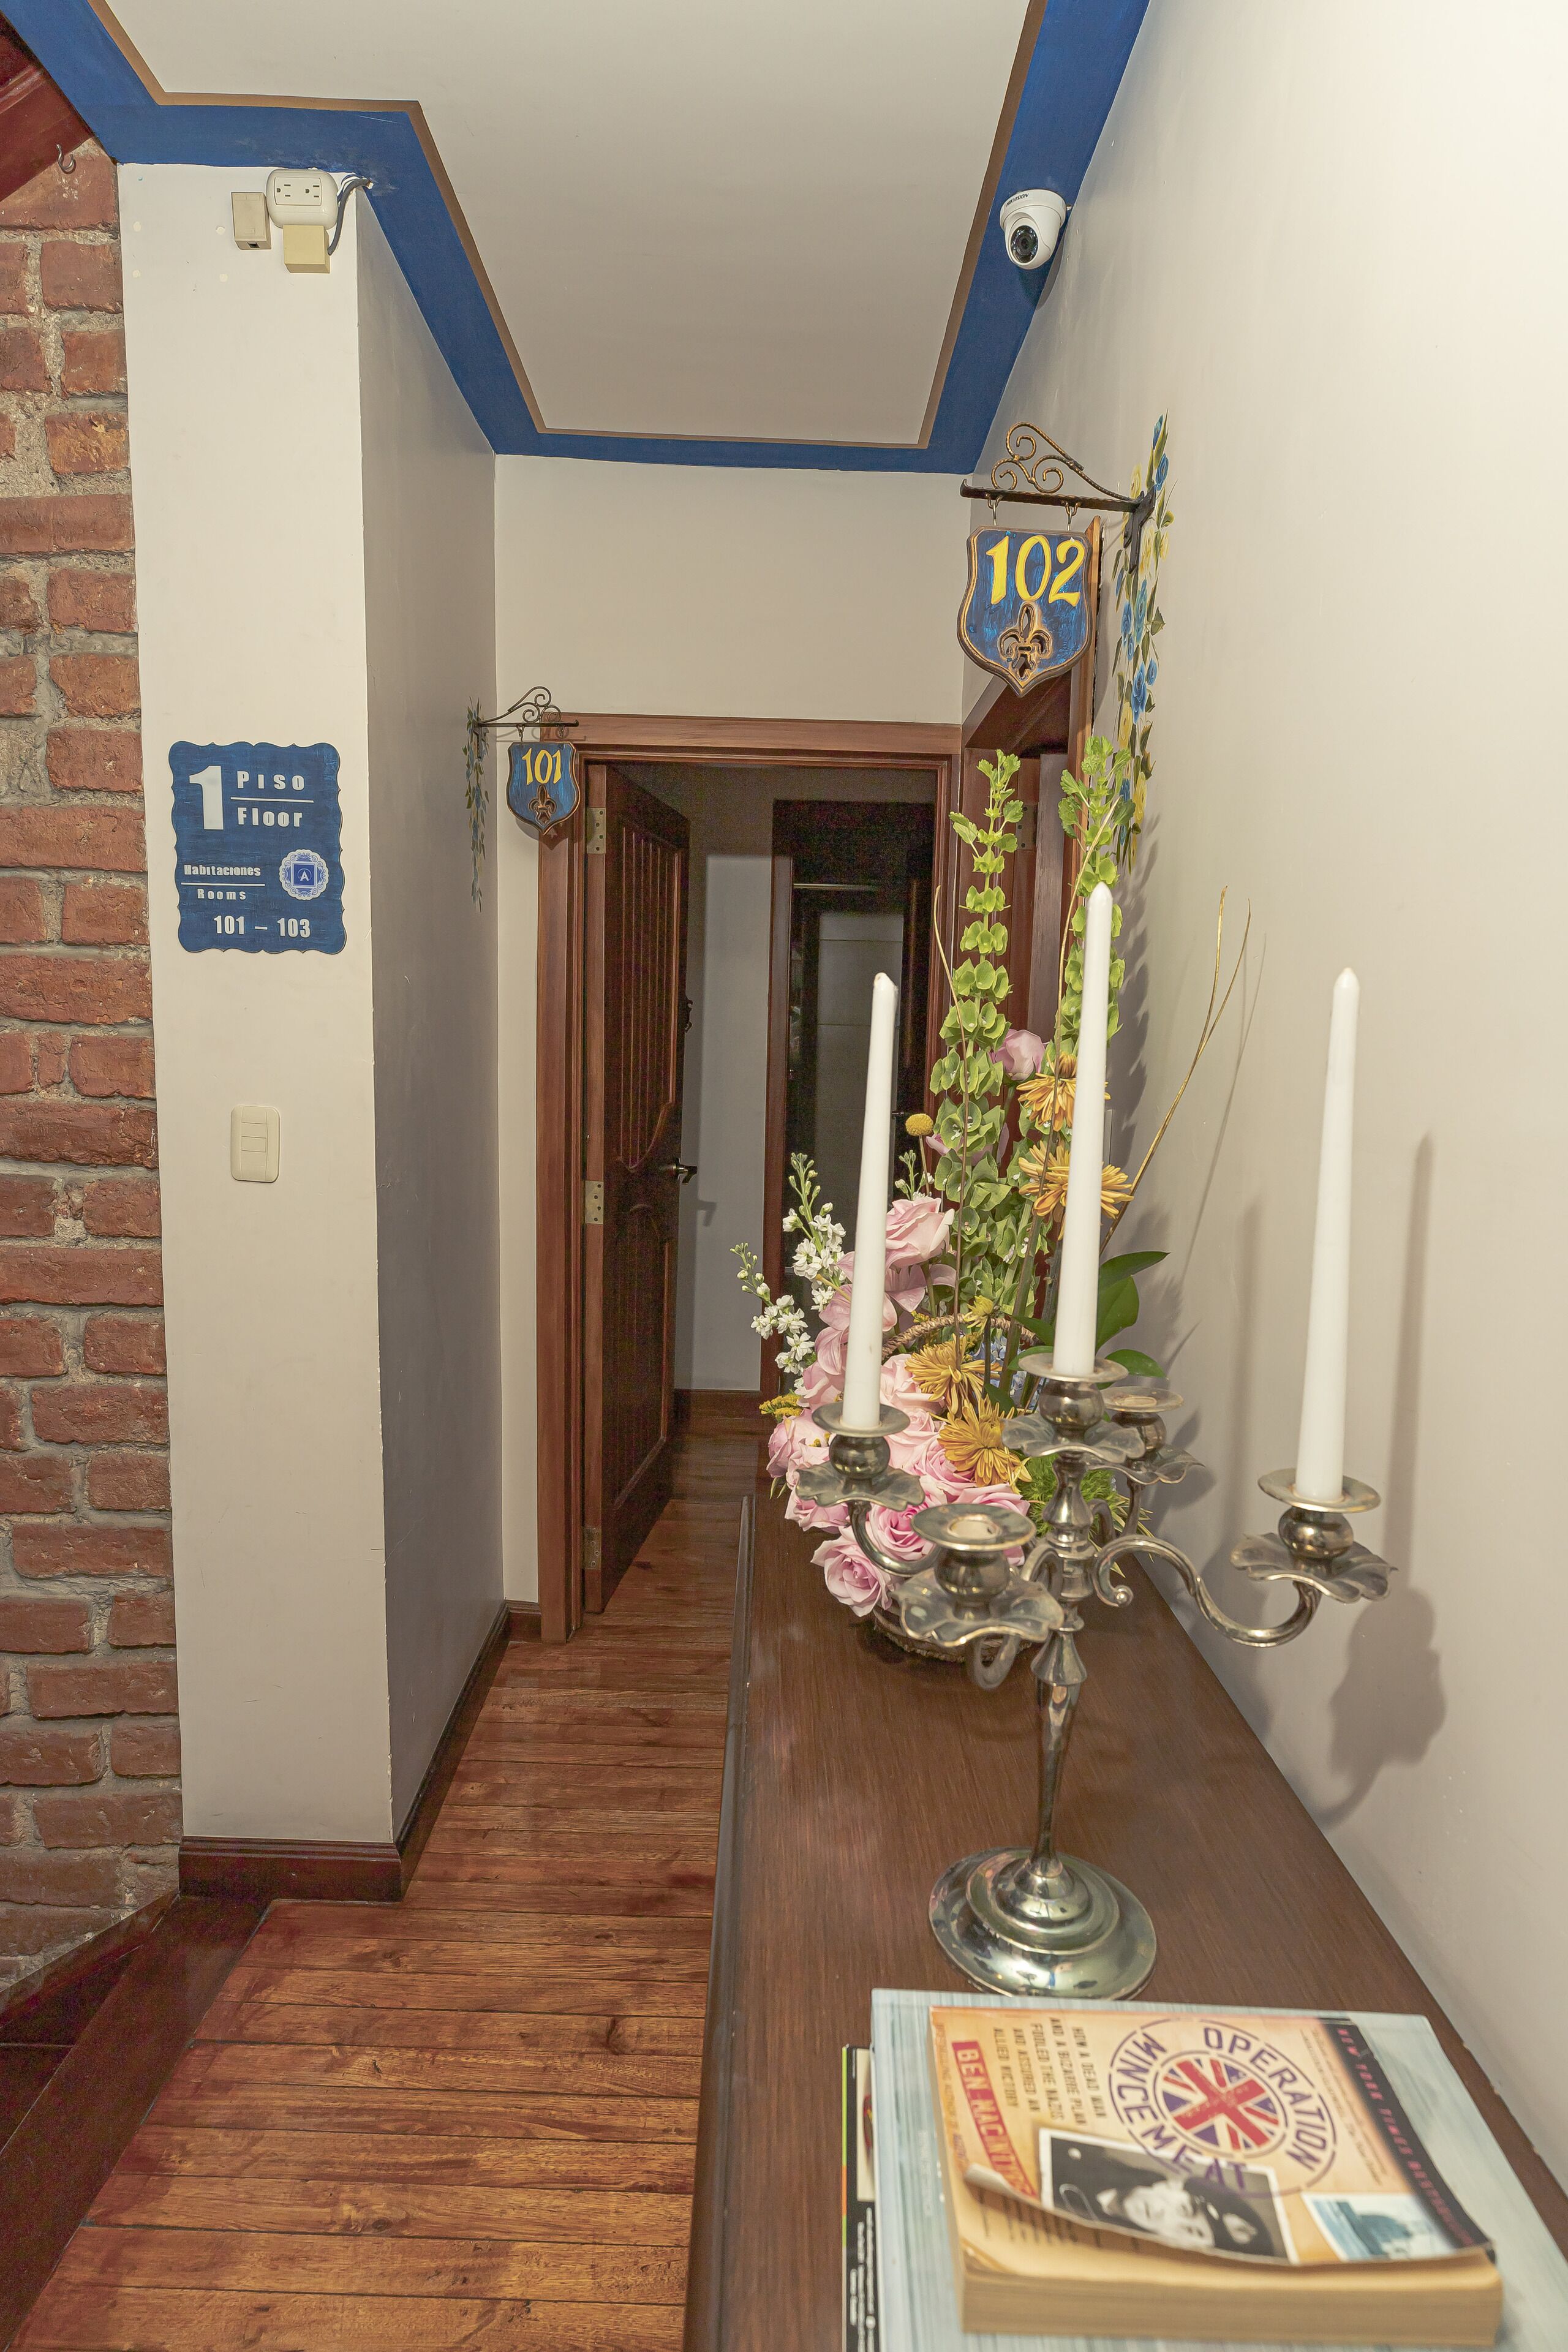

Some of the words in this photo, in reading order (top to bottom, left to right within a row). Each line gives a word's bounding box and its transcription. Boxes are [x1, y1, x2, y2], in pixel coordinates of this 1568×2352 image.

[1006, 193, 1030, 208] HIKVISION
[986, 535, 1085, 607] 102
[236, 771, 306, 791] Piso
[522, 747, 562, 785] 101
[189, 765, 224, 830] 1
[237, 807, 304, 827] Floor
[184, 864, 262, 877] Habitaciones
[197, 888, 247, 900] Rooms
[214, 915, 246, 935] 101
[277, 918, 311, 938] 103
[993, 2027, 1010, 2062] ALLIED
[1012, 2027, 1027, 2046] AND
[1031, 2022, 1050, 2064] FOOLED
[1050, 2017, 1065, 2037] AND
[956, 2048, 989, 2091] BEN
[1000, 2065, 1019, 2108] VICTORY
[1017, 2049, 1038, 2095] ASSURED
[1041, 2066, 1057, 2085] THE
[1057, 2051, 1080, 2095] BIZARRE
[1072, 2027, 1087, 2048] HOW
[1082, 2062, 1100, 2092] DEAD
[1091, 2095, 1106, 2119] MAN
[1028, 2099, 1041, 2113] AN
[1045, 2089, 1065, 2120] NAZIS
[1204, 2027, 1327, 2172] OPERATION
[1338, 2028, 1360, 2057] NEW
[1355, 2064, 1383, 2101] YORK
[1378, 2108, 1412, 2155] TIMES
[1069, 2098, 1087, 2125] PLAN
[970, 2099, 1037, 2196] MACINT
